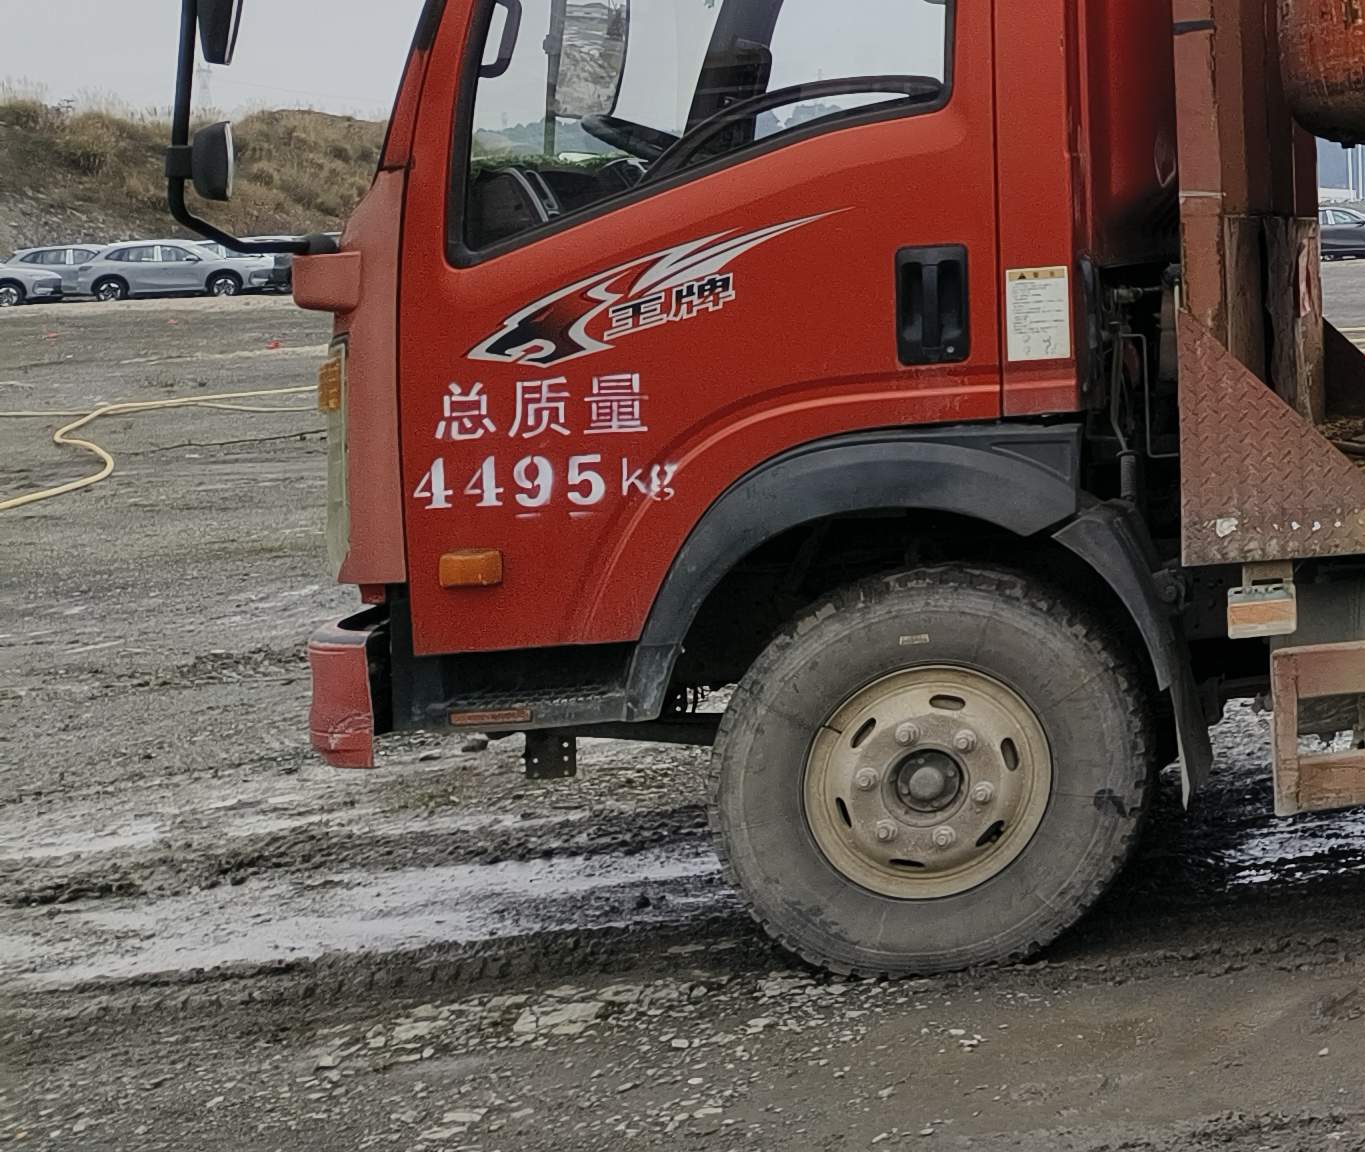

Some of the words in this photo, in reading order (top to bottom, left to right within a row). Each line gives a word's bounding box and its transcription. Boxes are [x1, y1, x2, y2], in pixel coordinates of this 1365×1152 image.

[604, 272, 736, 341] 王牌
[434, 373, 649, 441] 总质量
